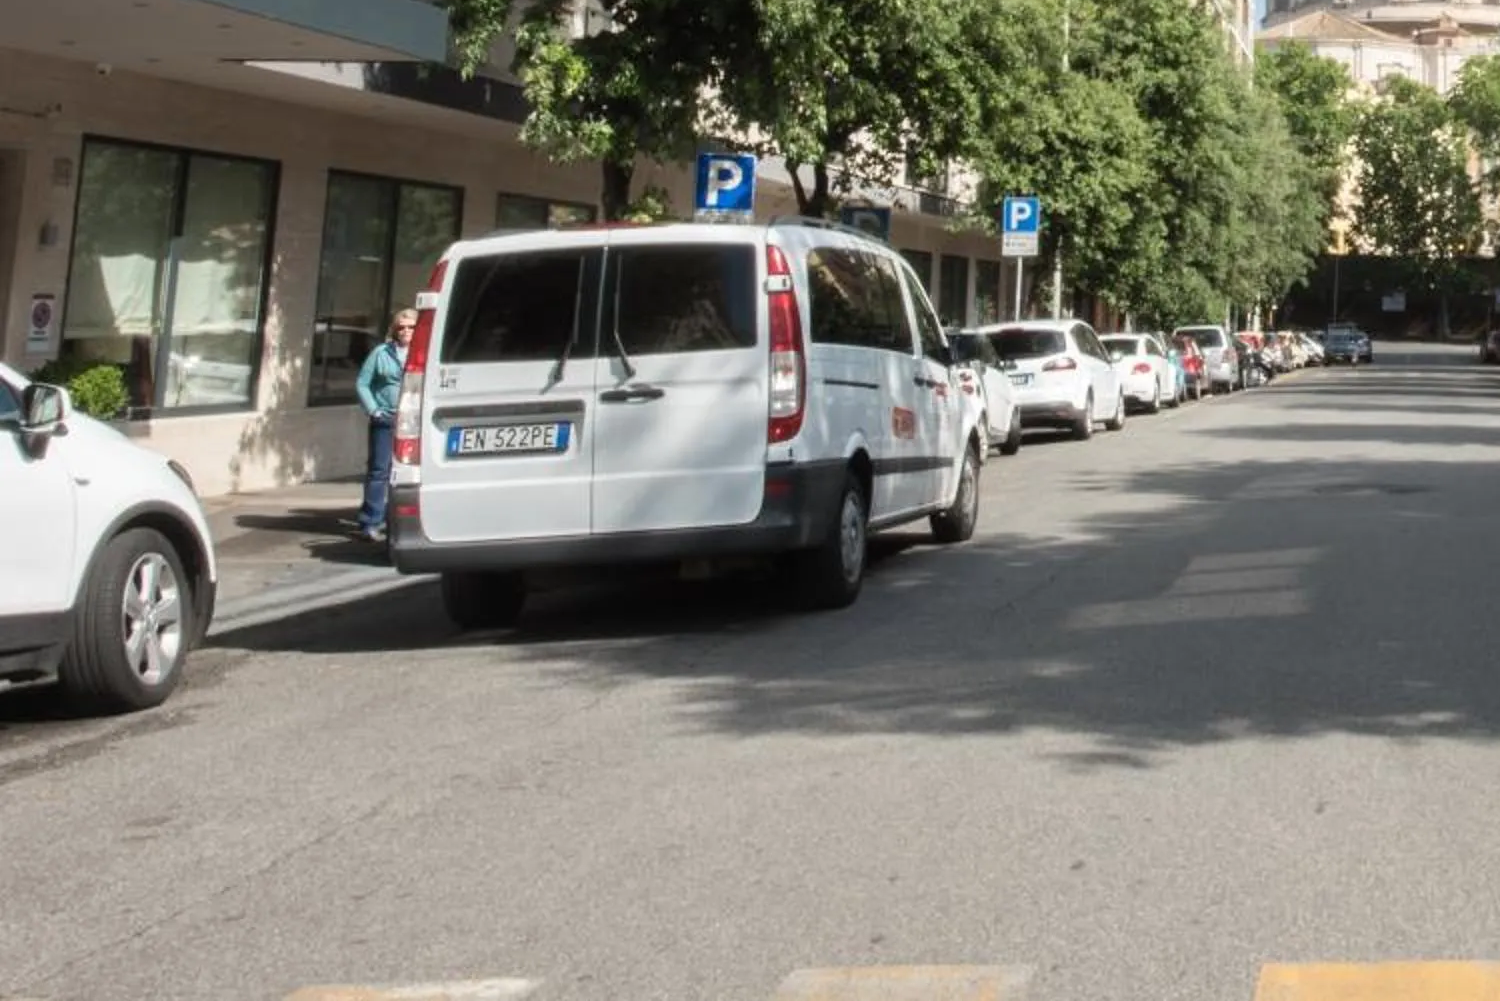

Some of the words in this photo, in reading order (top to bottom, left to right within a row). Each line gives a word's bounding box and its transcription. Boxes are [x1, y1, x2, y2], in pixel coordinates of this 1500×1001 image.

[706, 159, 743, 206] P
[1011, 202, 1032, 229] P
[462, 428, 486, 450] EN
[495, 426, 555, 448] 522PE
